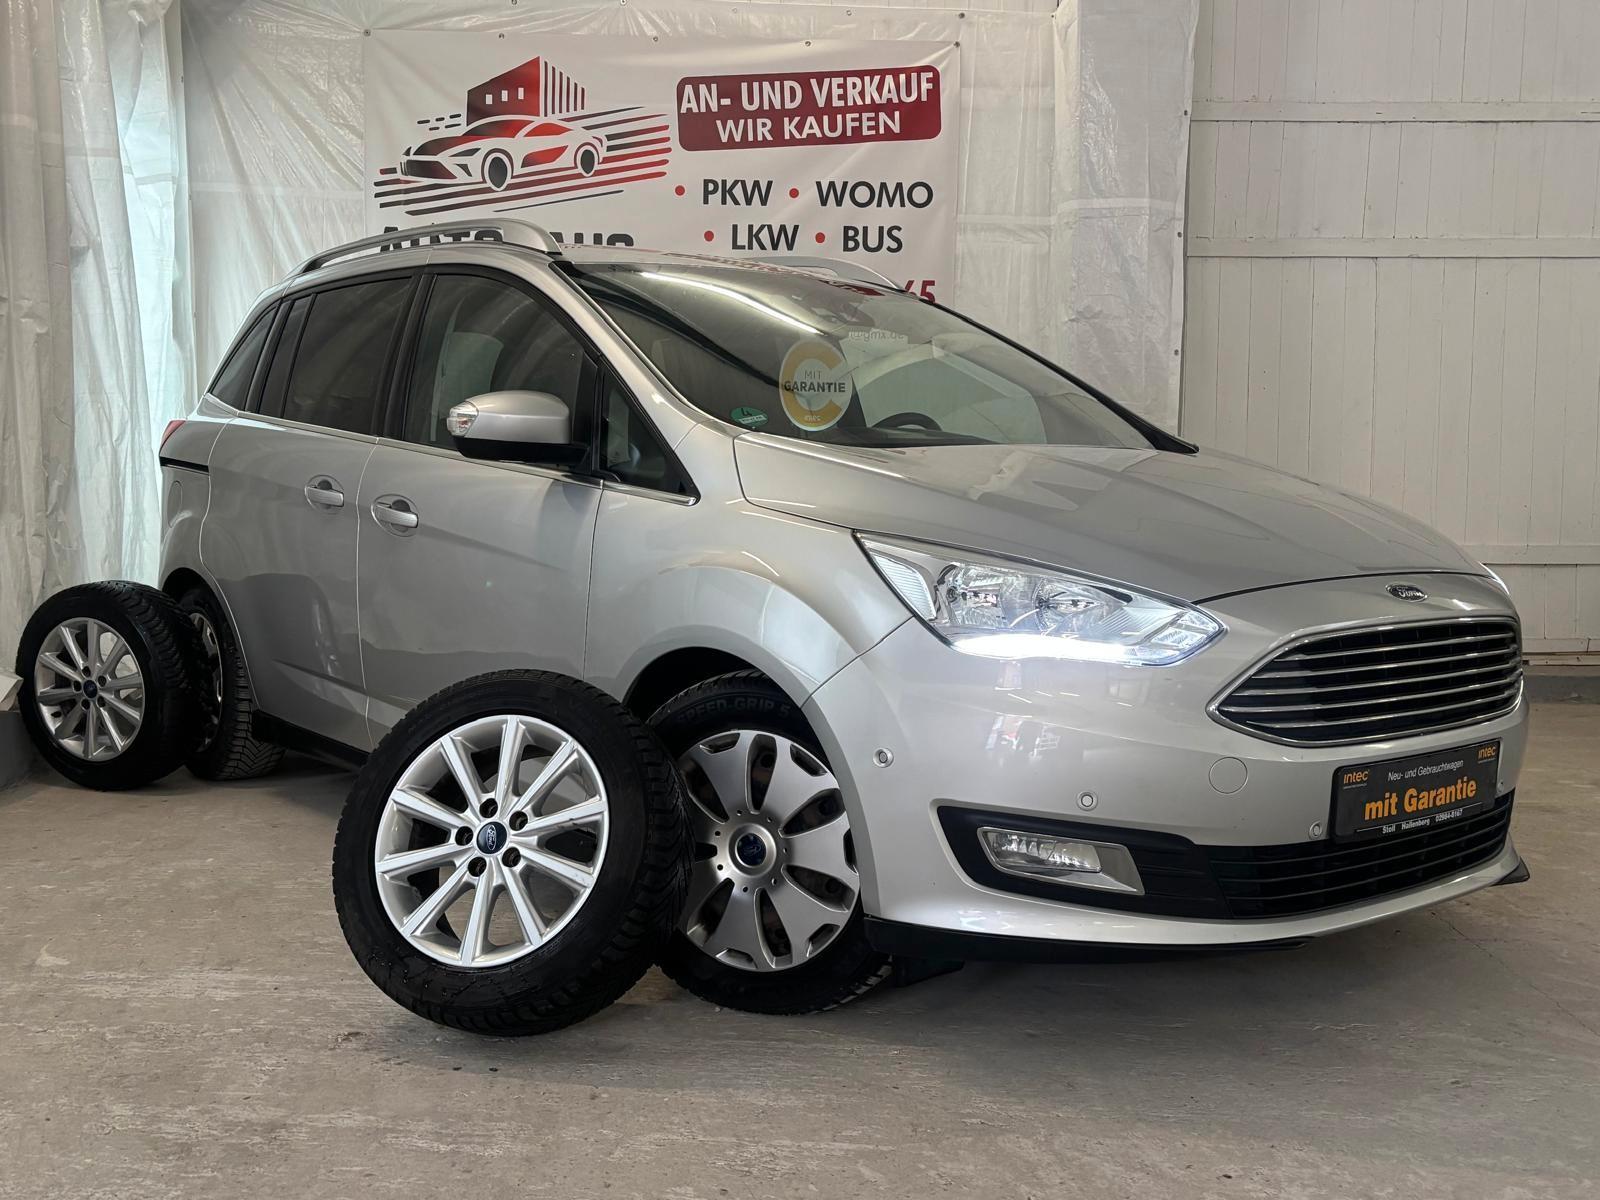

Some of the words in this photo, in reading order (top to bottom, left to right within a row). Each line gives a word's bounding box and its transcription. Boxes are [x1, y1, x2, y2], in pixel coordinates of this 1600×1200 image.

[680, 83, 731, 113] AN-
[741, 81, 802, 110] UND
[810, 72, 933, 107] VERKAUF
[716, 118, 773, 143] WIR
[784, 111, 900, 139] KAUFEN
[703, 179, 773, 206] PKW
[816, 181, 933, 208] WOMO
[732, 224, 799, 251] LKW
[843, 225, 903, 253] BUS
[783, 380, 846, 393] GARANTIE
[804, 371, 822, 380] MIT
[1387, 771, 1404, 781] Neu-
[1405, 768, 1417, 778] und
[1418, 760, 1464, 776] Gebrauchtwagen
[1364, 792, 1398, 820] mit
[1404, 776, 1477, 813] Garantie
